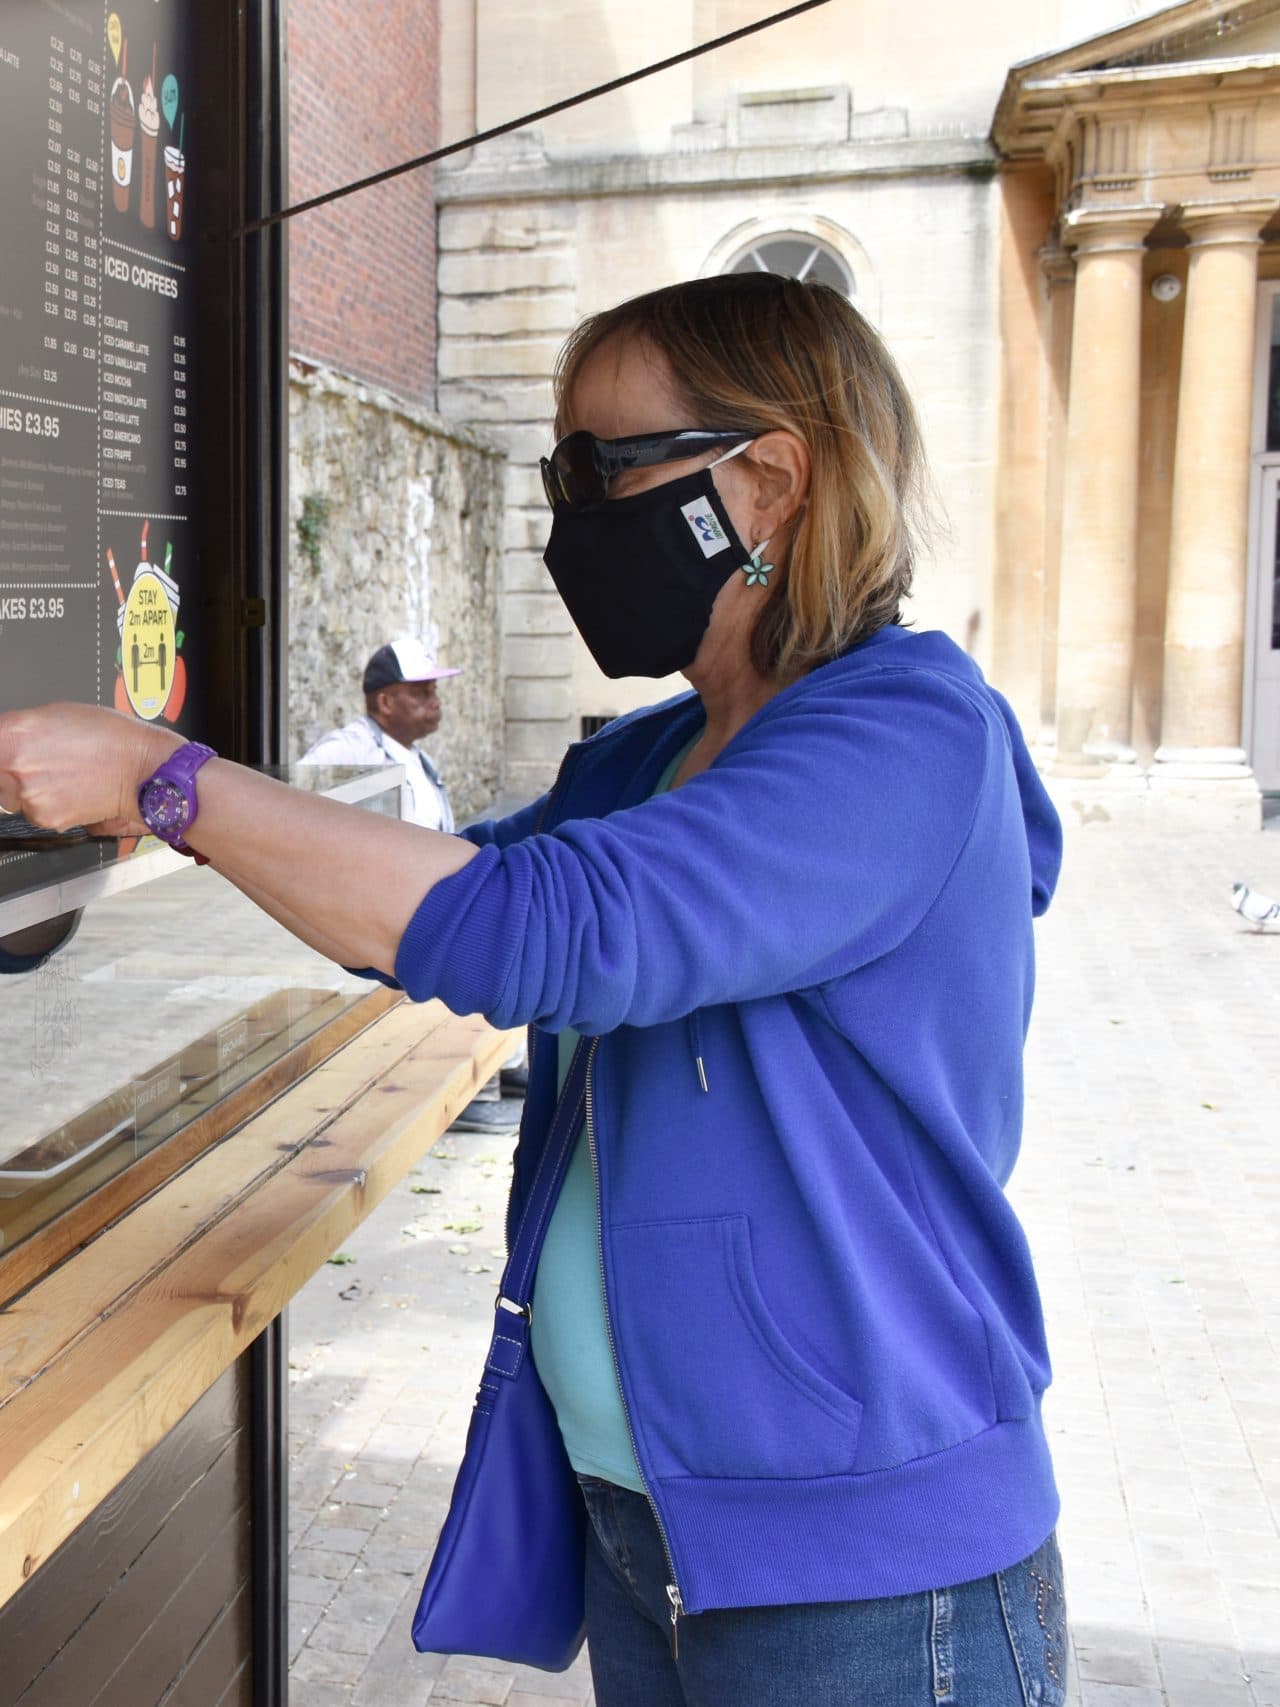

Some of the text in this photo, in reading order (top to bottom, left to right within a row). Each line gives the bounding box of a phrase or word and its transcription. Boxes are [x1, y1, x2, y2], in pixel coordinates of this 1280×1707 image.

[4, 50, 20, 70] LATTE
[104, 256, 178, 299] ICED COFFEES
[25, 412, 60, 438] £3.95
[114, 478, 126, 490] TEAS
[138, 589, 158, 606] STAY
[29, 597, 64, 619] £3.95
[129, 610, 168, 626] 2m APART
[143, 643, 155, 658] 2m
